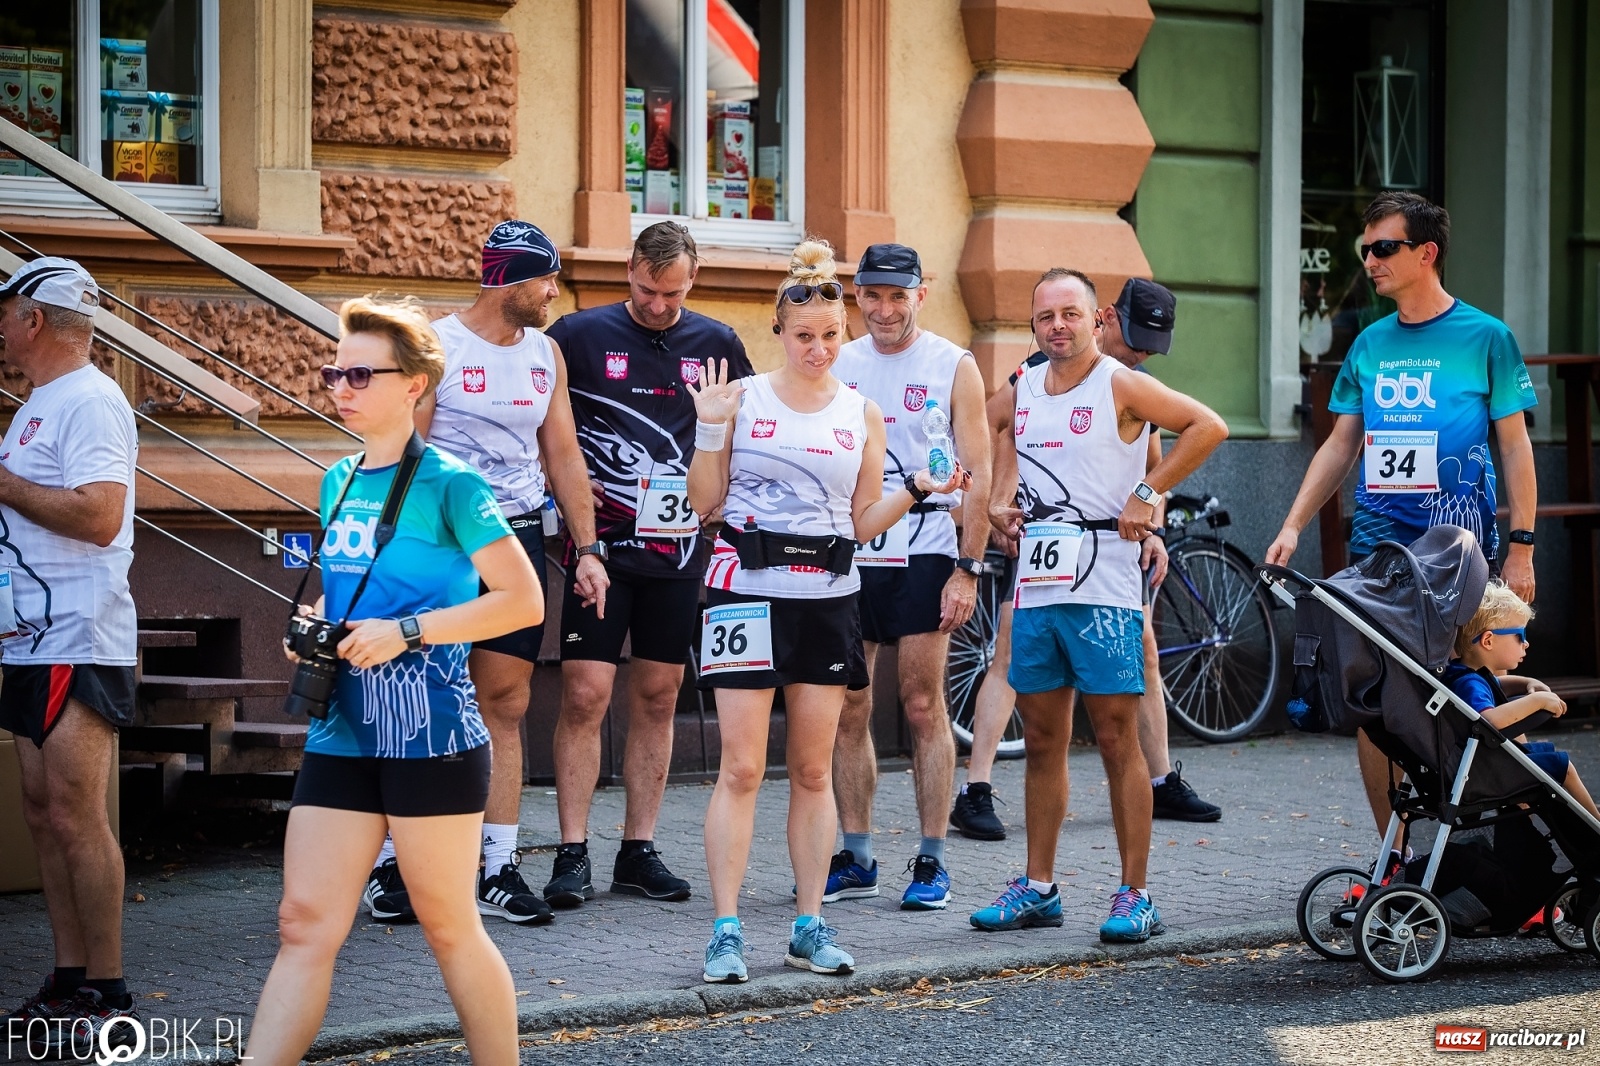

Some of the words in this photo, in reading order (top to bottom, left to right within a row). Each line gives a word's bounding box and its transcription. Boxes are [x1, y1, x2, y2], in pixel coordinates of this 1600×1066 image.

[32, 54, 60, 65] biovital
[168, 109, 191, 117] Centrum
[1380, 358, 1441, 369] BiegamBoLubię
[1374, 371, 1437, 409] bbl
[1383, 413, 1423, 423] RACIBÓRZ
[1379, 449, 1417, 479] 34
[657, 494, 694, 523] 39
[1037, 527, 1080, 536] KRZANOWICKI
[1029, 540, 1060, 571] 46
[720, 609, 765, 619] KRZANOWICKI
[711, 622, 748, 658] 36
[829, 663, 845, 671] 4F
